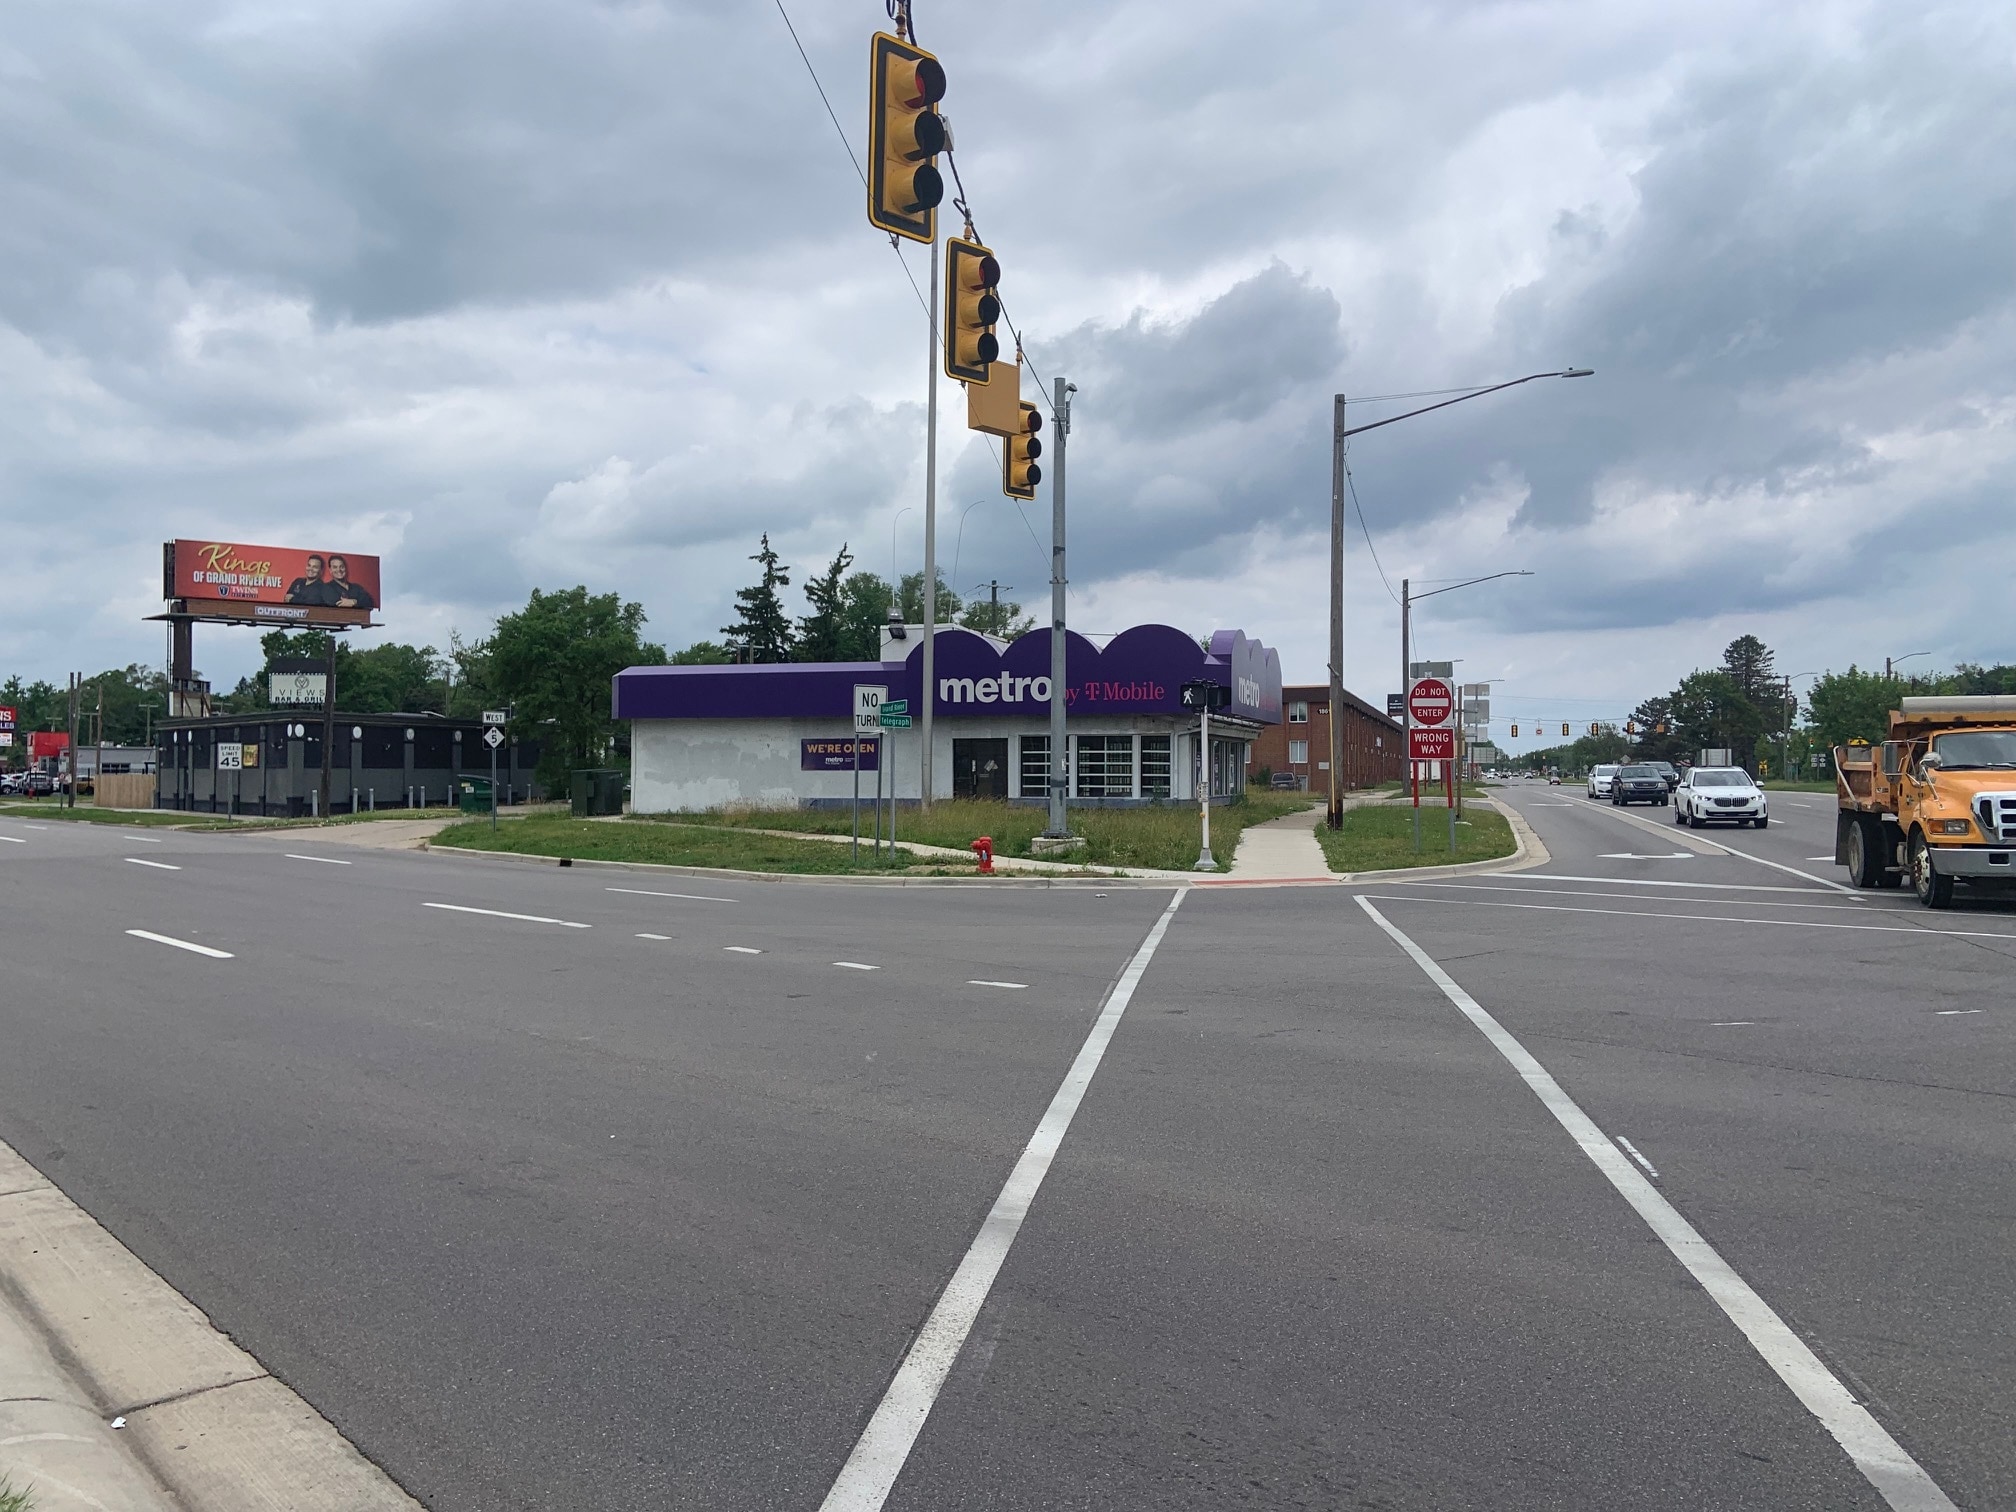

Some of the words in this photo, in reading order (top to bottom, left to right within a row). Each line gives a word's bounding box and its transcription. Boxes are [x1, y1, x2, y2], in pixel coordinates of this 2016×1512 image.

[198, 544, 271, 576] Kings
[193, 571, 205, 582] OF
[206, 571, 237, 584] GRAND
[239, 574, 264, 587] RIVER
[266, 576, 282, 588] AVE
[231, 586, 258, 594] TWINS
[257, 607, 306, 617] OUTFRONT
[939, 671, 1052, 703] metro
[1103, 681, 1165, 701] Mobile
[1238, 674, 1260, 708] metro
[1415, 688, 1426, 696] DO
[1430, 688, 1446, 696] NOT
[862, 692, 879, 708] NO
[485, 713, 503, 721] WEST
[1417, 709, 1443, 717] ENTER
[881, 717, 910, 727] Telegraph
[491, 735, 498, 743] 5
[1414, 733, 1449, 742] WRONG
[807, 744, 842, 753] WE'RE
[1421, 745, 1442, 754] WAY
[220, 757, 240, 767] 45
